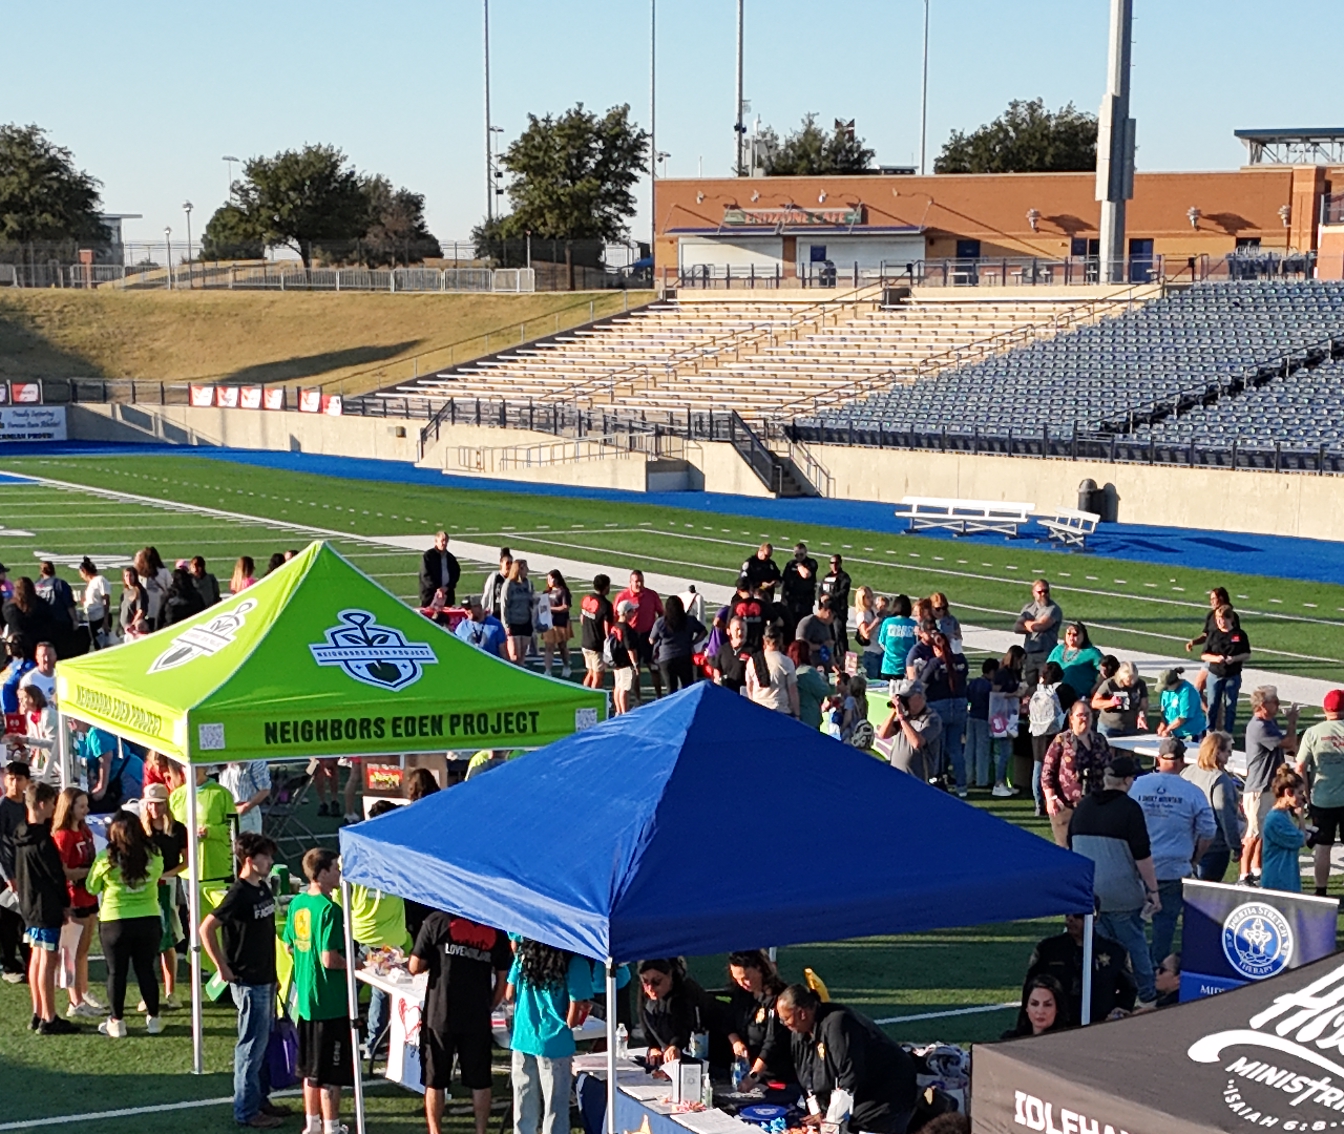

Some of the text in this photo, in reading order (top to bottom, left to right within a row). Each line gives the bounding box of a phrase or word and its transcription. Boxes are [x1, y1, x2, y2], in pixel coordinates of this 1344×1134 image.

[811, 211, 846, 224] CAFE
[317, 649, 366, 658] NEIGHBORS
[392, 647, 432, 657] PROJECT
[264, 710, 541, 746] NEIGHBORS EDEN PROJECT
[1238, 960, 1274, 975] THERAPY
[1224, 1084, 1279, 1128] ISAIAH
